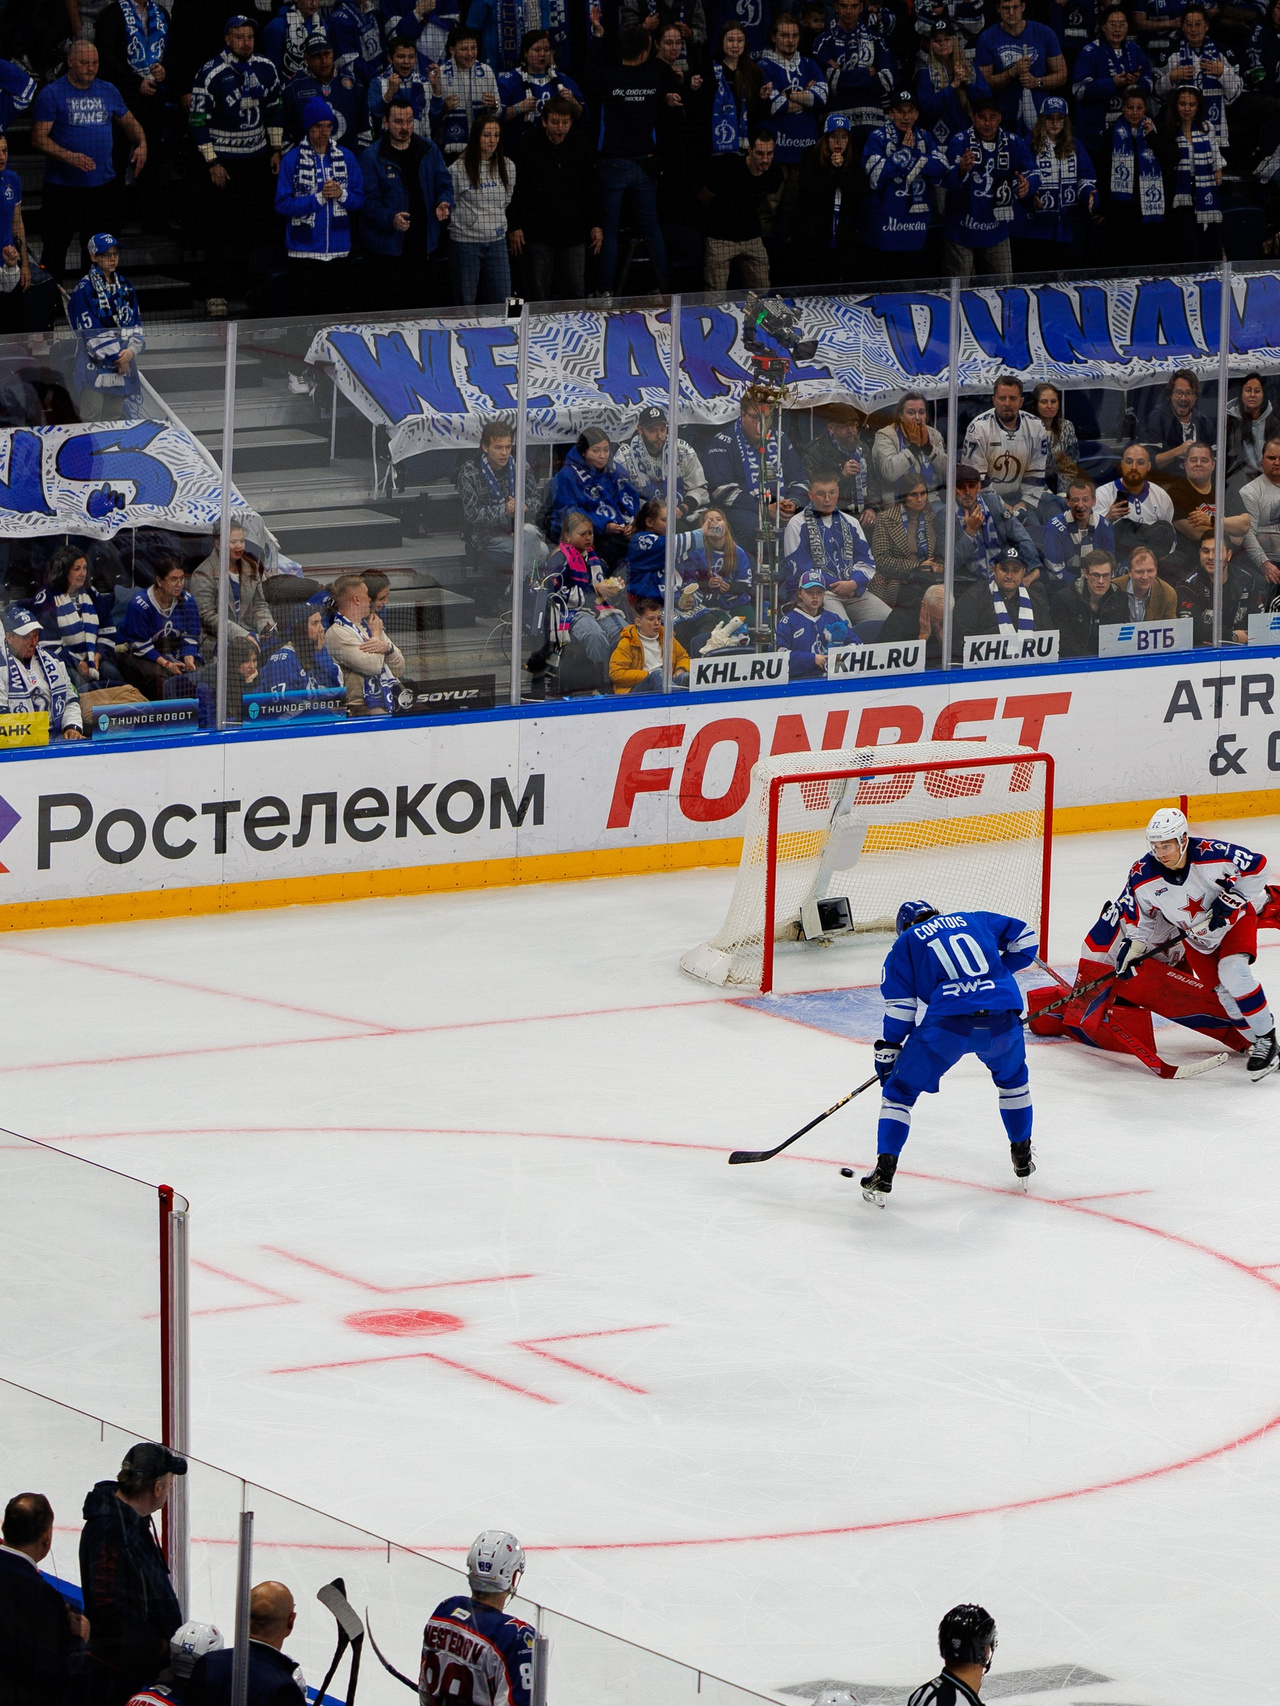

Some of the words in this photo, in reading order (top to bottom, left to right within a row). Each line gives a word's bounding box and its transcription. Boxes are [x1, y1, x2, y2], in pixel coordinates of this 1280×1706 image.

[882, 216, 927, 232] Москва
[326, 325, 555, 426] WE
[968, 636, 1054, 663] KHL.RU
[1137, 627, 1176, 650] ВТБ
[695, 658, 784, 685] KHL.RU
[833, 646, 920, 674] KHL.RU
[261, 700, 342, 715] THUNDEROBOT
[416, 689, 480, 703] SOYUZ
[110, 711, 193, 727] THUNDEROBOT
[606, 691, 1073, 829] FONBET
[1208, 733, 1248, 776] &
[37, 773, 546, 871] Ростелеком
[1232, 849, 1254, 871] 22
[913, 915, 968, 941] COMTOIS
[926, 932, 990, 981] 10
[1166, 970, 1205, 990] BAUER
[479, 1561, 491, 1572] 89
[424, 1624, 486, 1665] NESTEROV
[518, 1662, 534, 1690] 8
